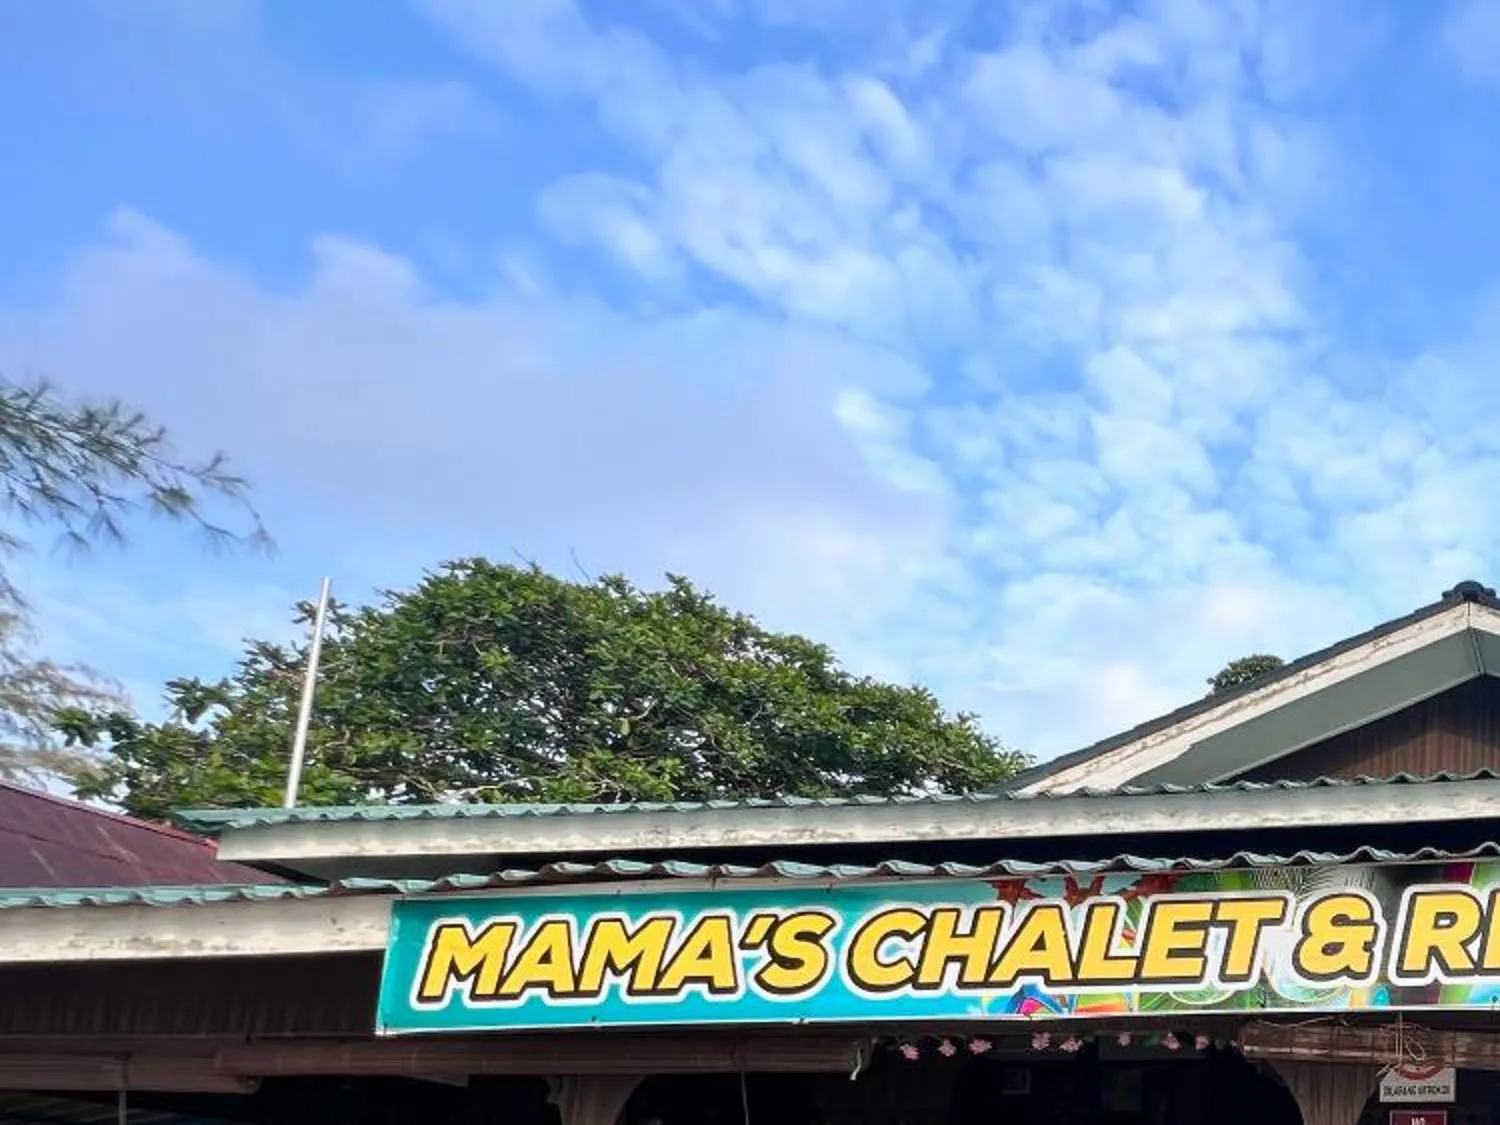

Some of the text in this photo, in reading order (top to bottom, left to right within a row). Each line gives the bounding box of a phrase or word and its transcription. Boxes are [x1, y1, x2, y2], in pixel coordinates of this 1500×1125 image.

[415, 908, 838, 1001] MAMA'S
[847, 895, 1289, 992] CHALET
[1296, 892, 1379, 982] &
